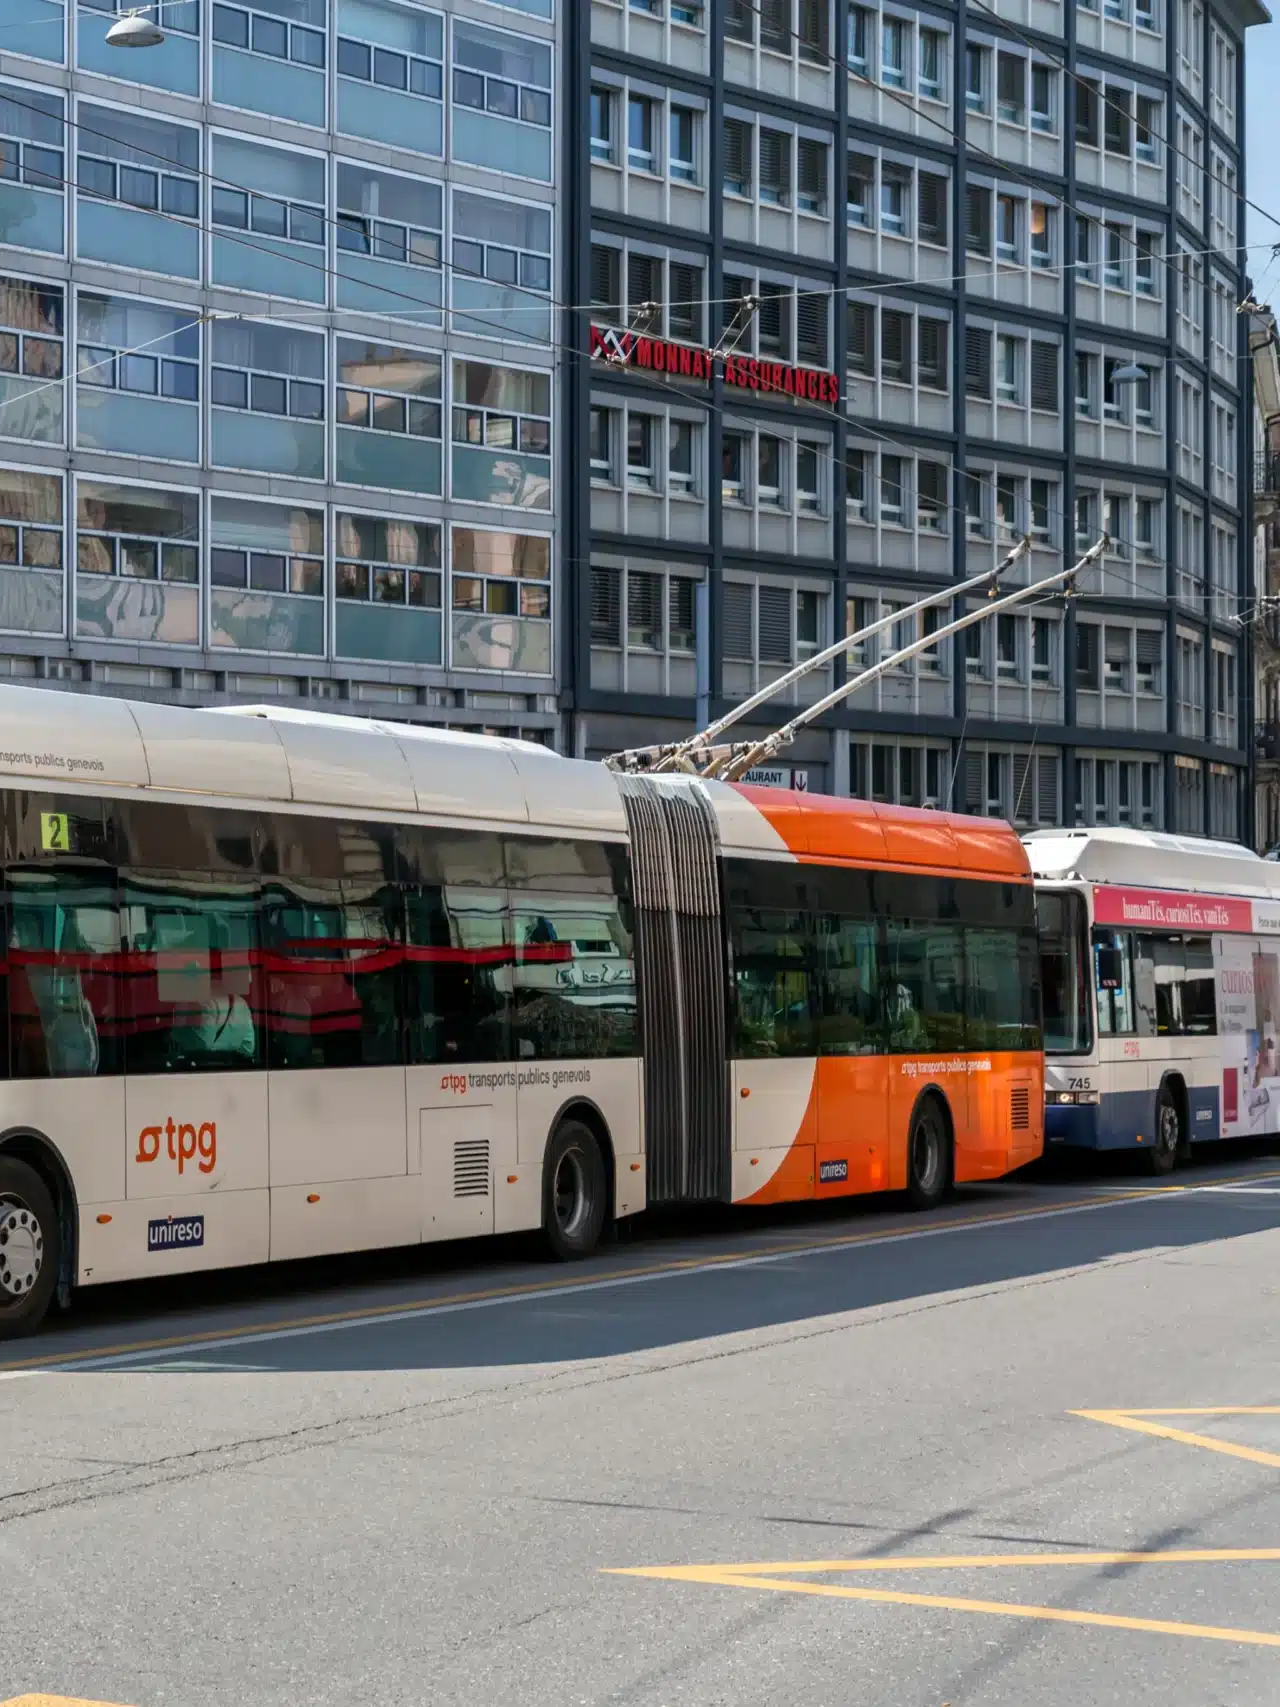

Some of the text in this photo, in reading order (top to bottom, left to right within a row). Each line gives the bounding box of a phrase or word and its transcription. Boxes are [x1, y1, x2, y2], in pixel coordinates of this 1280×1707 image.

[636, 337, 839, 403] MONNAY ASSURANCES
[34, 753, 65, 768] publics
[66, 759, 105, 771] genevois
[742, 771, 783, 784] AURANT
[48, 815, 62, 849] 2
[468, 1071, 516, 1091] transports
[518, 1068, 550, 1090] publics
[552, 1066, 591, 1088] genevois
[1068, 1077, 1091, 1090] 745
[820, 1161, 847, 1179] unireso
[149, 1215, 203, 1244] unireso
